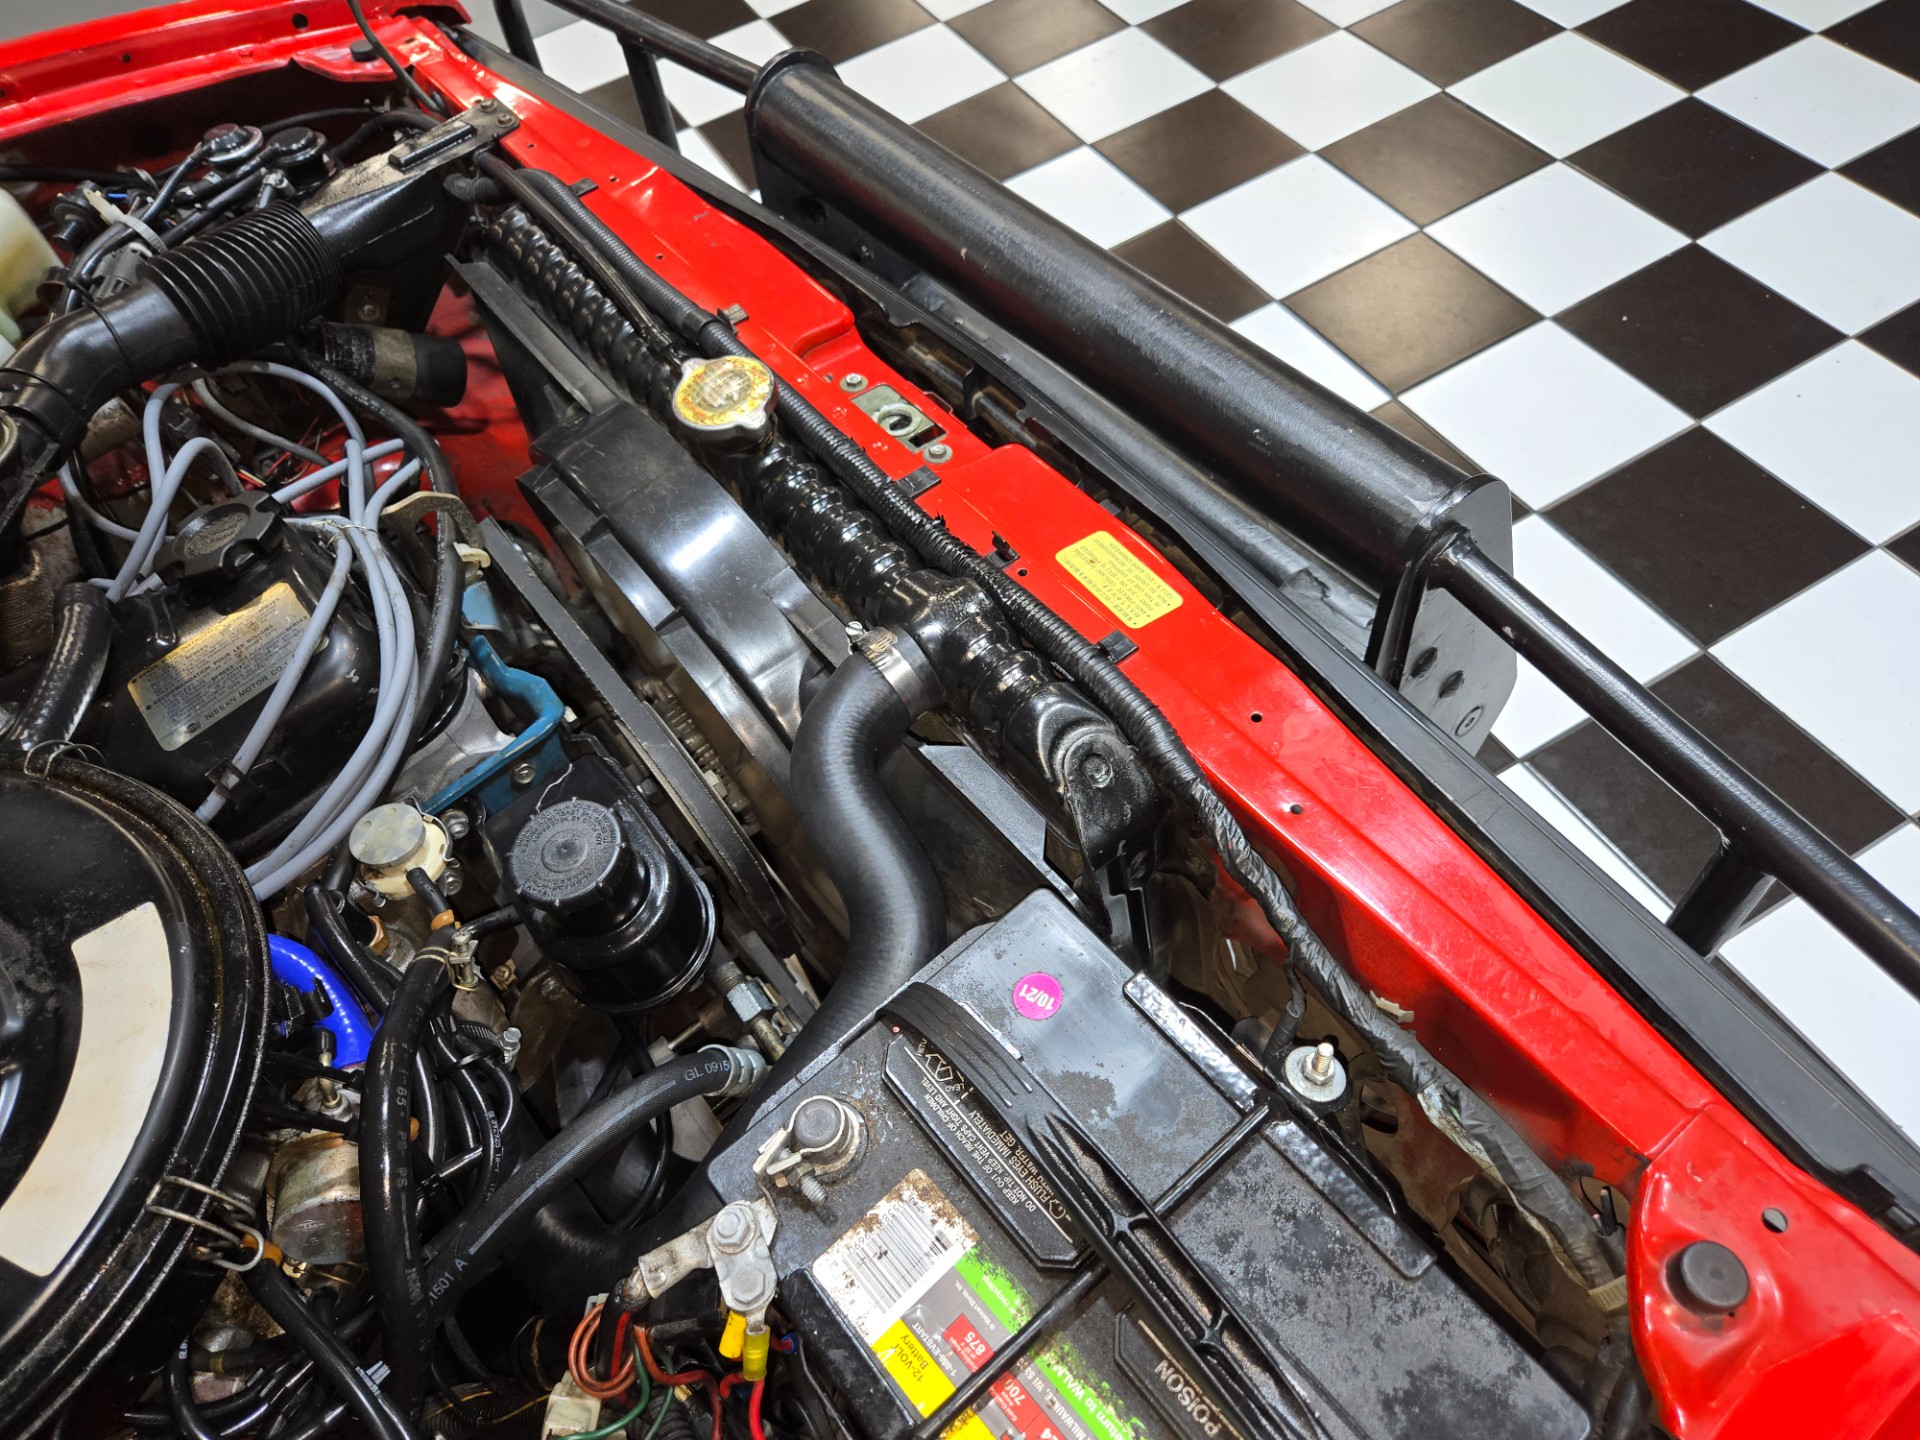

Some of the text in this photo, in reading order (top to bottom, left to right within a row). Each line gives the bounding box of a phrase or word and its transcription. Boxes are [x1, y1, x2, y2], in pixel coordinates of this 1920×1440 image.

[233, 643, 244, 652] LES
[204, 696, 236, 720] NISSAN
[238, 675, 268, 697] MOTOR
[1017, 983, 1057, 1011] 10/21
[683, 1065, 704, 1081] GL
[945, 1083, 964, 1092] LEAD
[919, 1076, 1036, 1212] DO NOT TIP. KEEP VENT CAPS TIGHT AND LEVEL
[922, 1092, 1019, 1205] KEEP OUT OF THE REACH OF CHILDREN
[999, 1128, 1016, 1147] GET
[967, 1108, 1050, 1202] FLUSH EYES IMMEDIATELY
[451, 1255, 468, 1272] A
[898, 1333, 930, 1369] Battery
[911, 1321, 959, 1376] 1-888-EVSTART
[963, 1330, 987, 1355] 875
[890, 1341, 925, 1382] 12-VOLT
[1081, 1396, 1098, 1413] to
[1152, 1358, 1224, 1438] POISON
[1093, 1409, 1124, 1440] eturn
